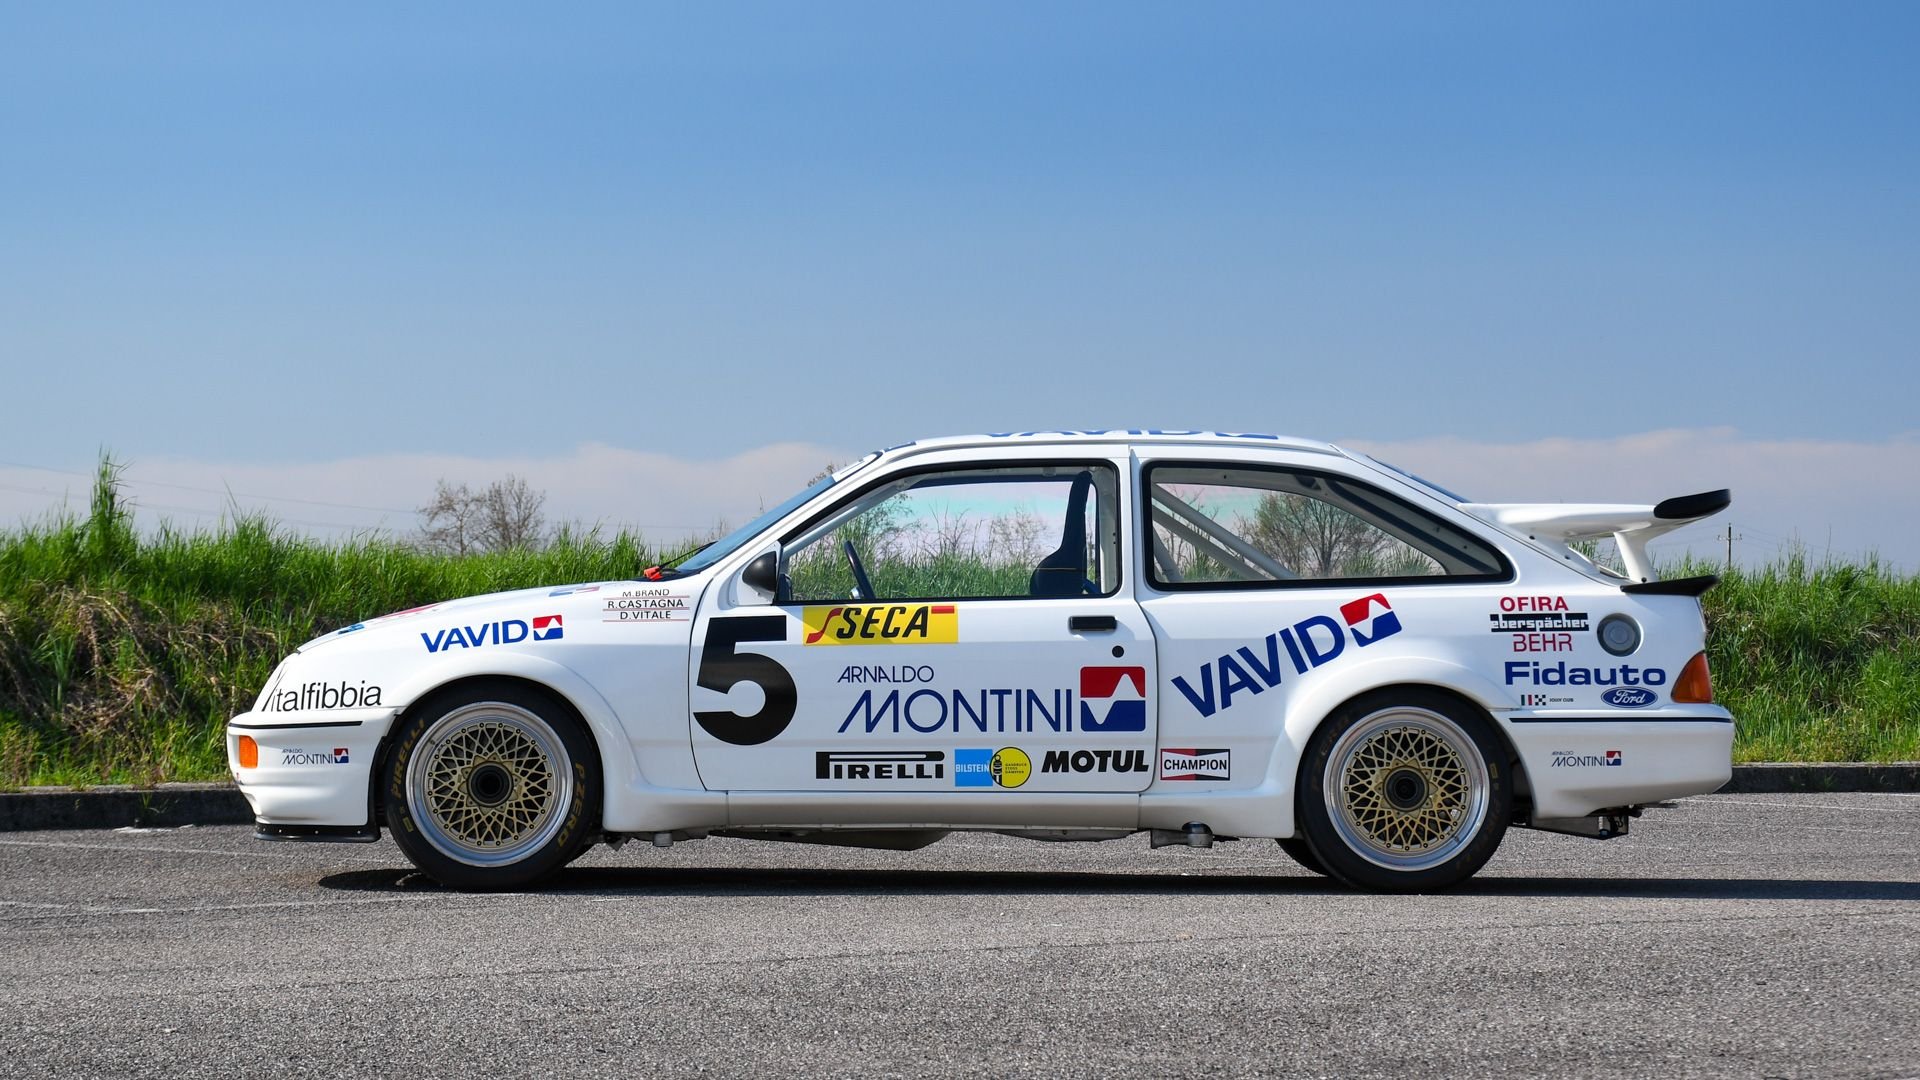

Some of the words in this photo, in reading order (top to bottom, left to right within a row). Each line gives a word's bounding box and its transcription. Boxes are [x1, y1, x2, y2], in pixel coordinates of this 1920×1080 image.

[622, 588, 670, 598] M.BRAND
[607, 598, 684, 609] R.CASTAGNA
[1499, 596, 1569, 611] OFIRA
[620, 610, 671, 620] D.VITALE
[1490, 612, 1589, 632] eberspächer
[421, 619, 529, 653] VAVID
[1513, 633, 1573, 652] BEHR
[836, 665, 934, 684] ARNALDO
[1170, 615, 1346, 718] VAVID
[1505, 661, 1667, 686] Fidauto
[692, 615, 798, 746] 5
[1612, 689, 1645, 704] Ford
[836, 688, 1073, 733] MONTINI
[282, 753, 333, 765] MONTINI
[391, 717, 425, 800] PIRELLI
[815, 751, 945, 780] PIRELLI
[955, 763, 990, 773] BILSTEIN
[1040, 750, 1149, 773] MOTUL
[1162, 758, 1228, 773] CHAMPION
[1551, 756, 1605, 768] MONTINI
